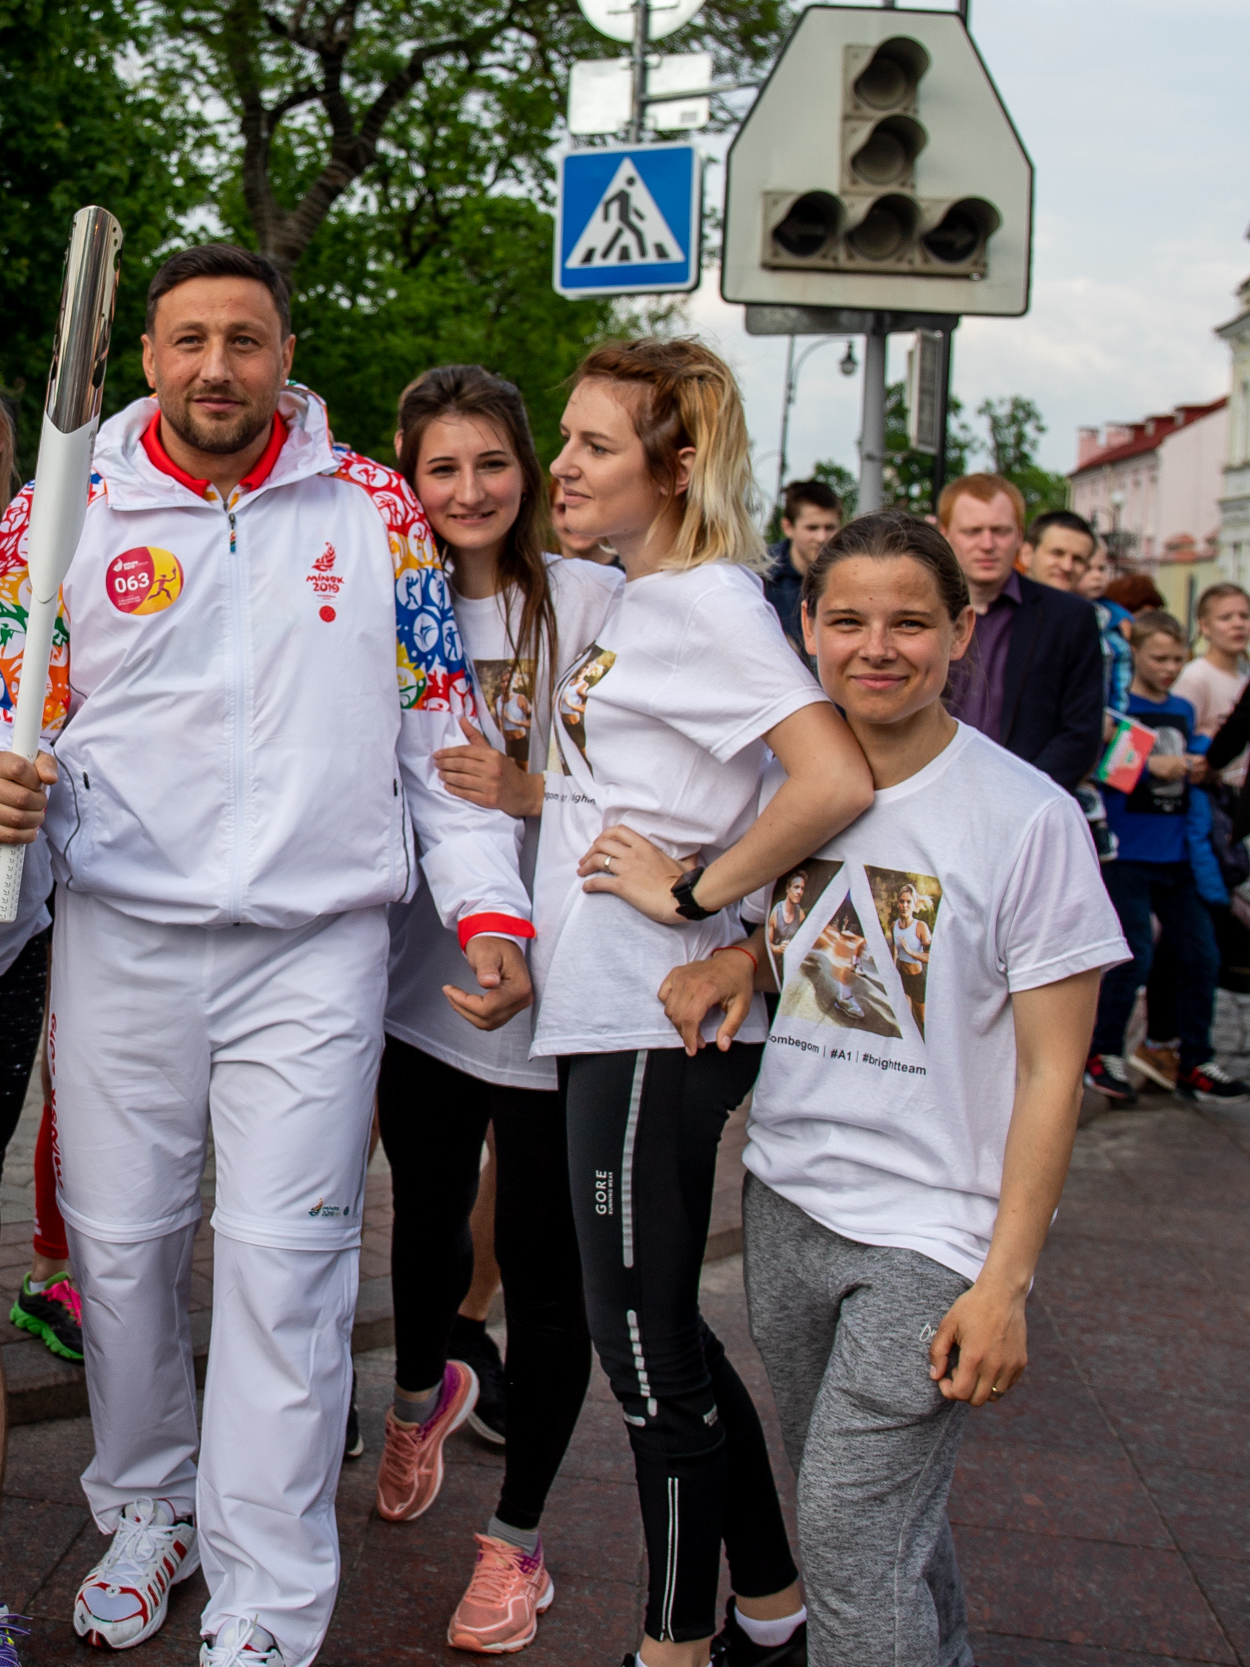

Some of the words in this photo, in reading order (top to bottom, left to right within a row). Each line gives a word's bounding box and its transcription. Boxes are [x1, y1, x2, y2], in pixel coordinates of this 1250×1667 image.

[114, 572, 150, 594] 063
[313, 583, 340, 593] 2019
[830, 1048, 852, 1061] #A1
[862, 1052, 927, 1076] #brightteam
[595, 1169, 607, 1215] GORE
